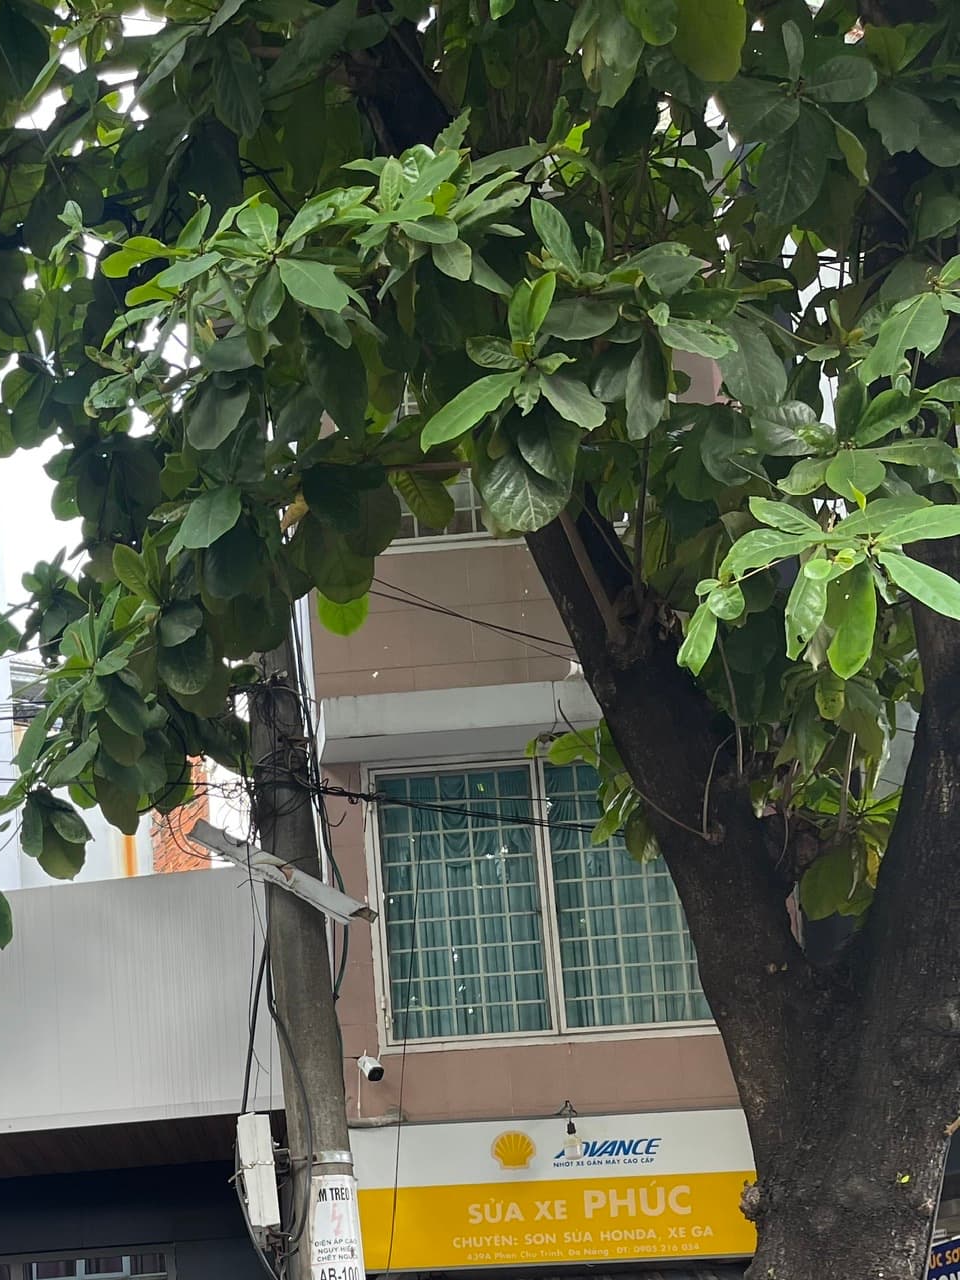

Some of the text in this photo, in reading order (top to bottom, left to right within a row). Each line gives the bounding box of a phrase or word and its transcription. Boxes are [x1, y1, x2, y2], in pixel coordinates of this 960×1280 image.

[623, 1156, 639, 1164] CAO
[534, 1199, 568, 1221] XE
[583, 1180, 692, 1219] PHÚC
[667, 1226, 687, 1239] XE
[691, 1225, 714, 1238] GA
